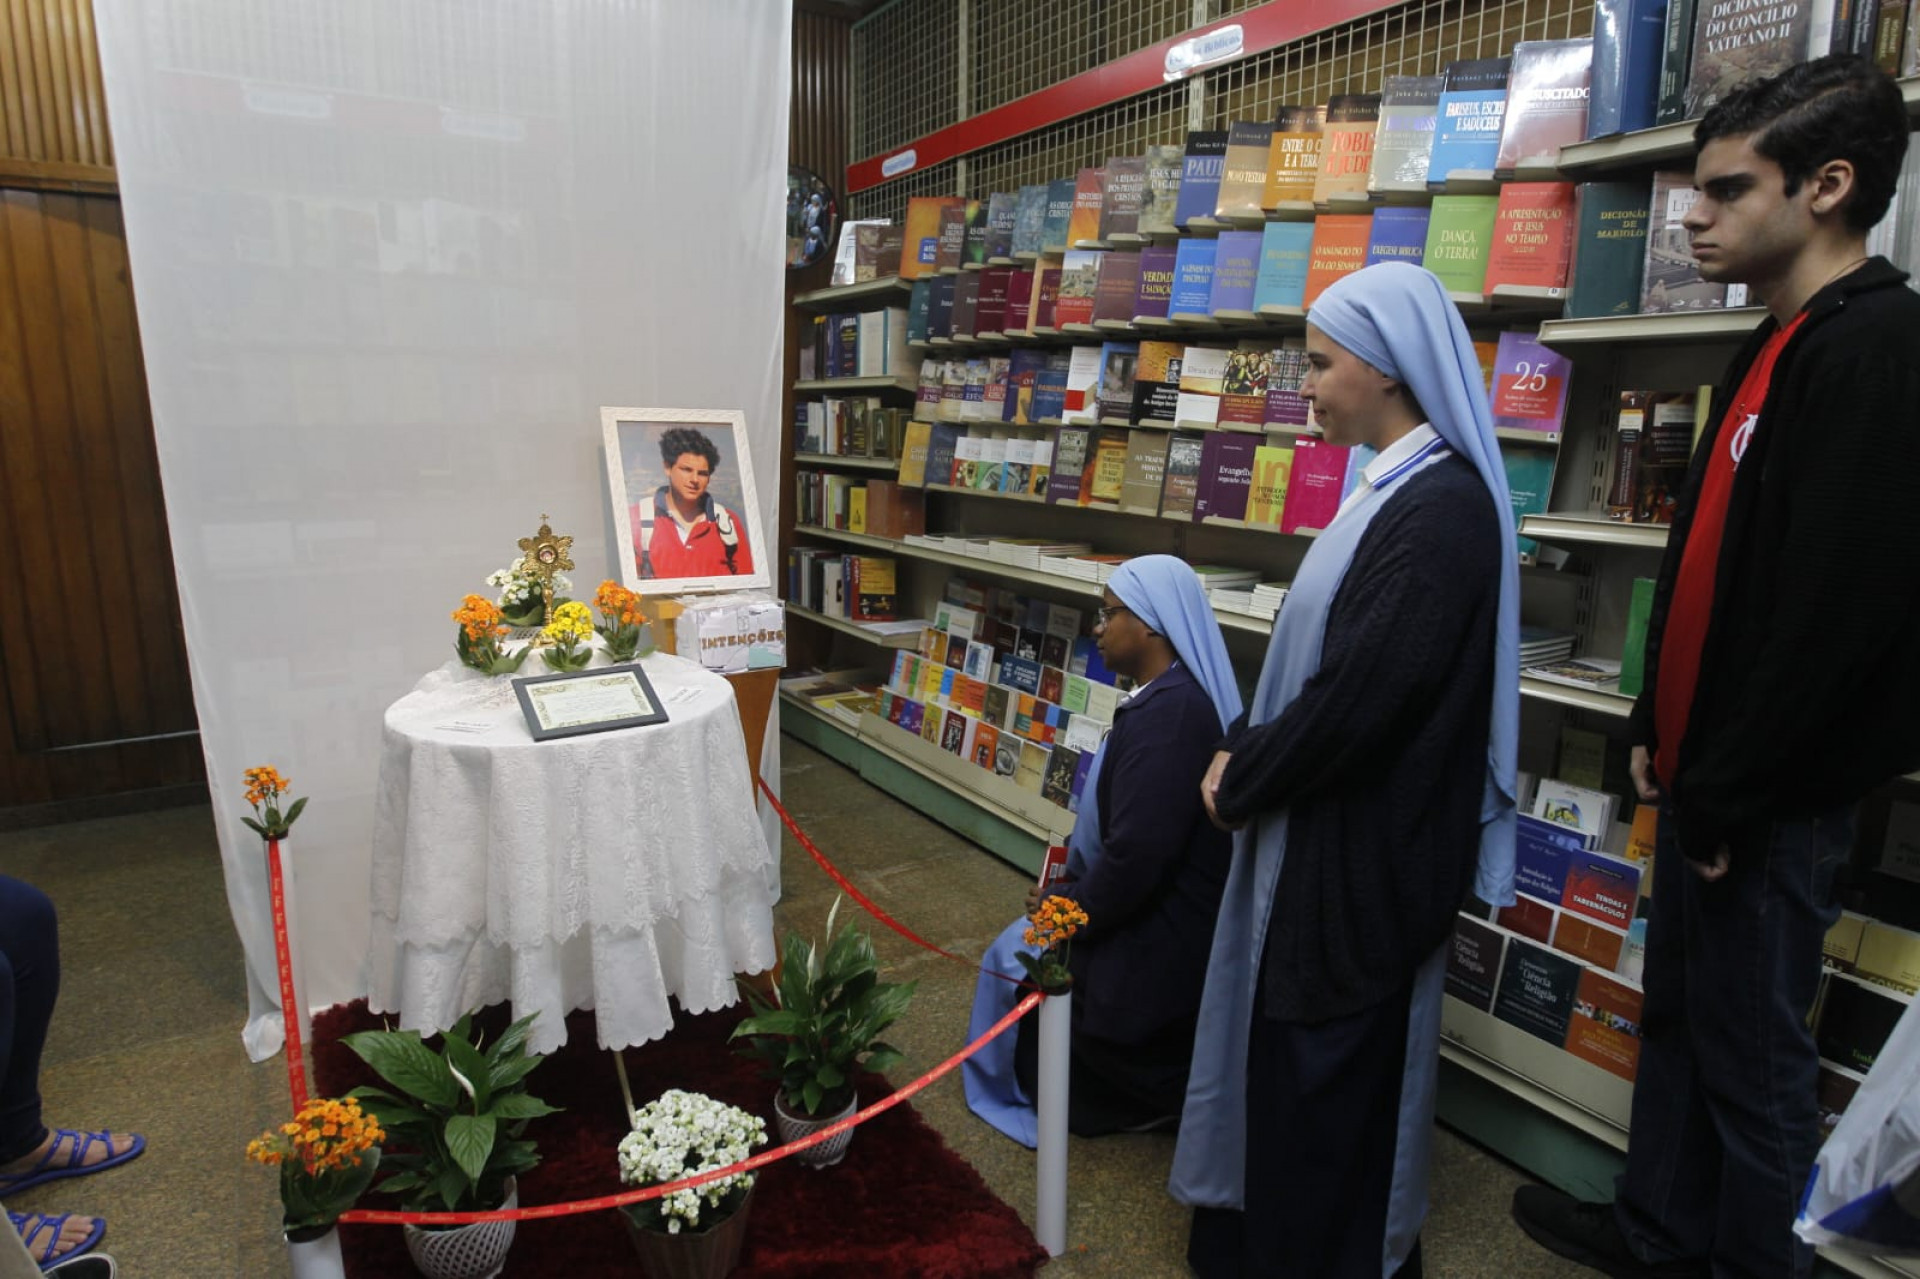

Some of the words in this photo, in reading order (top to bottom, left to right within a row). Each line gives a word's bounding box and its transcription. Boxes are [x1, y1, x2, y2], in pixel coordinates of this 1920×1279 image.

[1705, 20, 1726, 38] DO
[1728, 3, 1798, 31] CONCÍLIO
[1708, 26, 1776, 54] VATICANO
[1779, 22, 1790, 38] II
[1281, 138, 1304, 153] ENTRE
[1508, 208, 1562, 221] APRESENTAÇÃO
[1512, 222, 1523, 232] DE
[1524, 221, 1544, 232] JESUS
[1622, 220, 1637, 229] DE
[1505, 234, 1518, 244] NO
[1519, 234, 1549, 245] TEMPLO
[1445, 246, 1479, 260] TERRA!
[1511, 361, 1550, 392] 25
[701, 628, 785, 650] INTENÇÕES
[1573, 895, 1626, 919] TABERNÁCULOS
[1595, 893, 1622, 908] TENDAS
[1523, 968, 1551, 988] Ciência
[1524, 981, 1558, 1003] Religião
